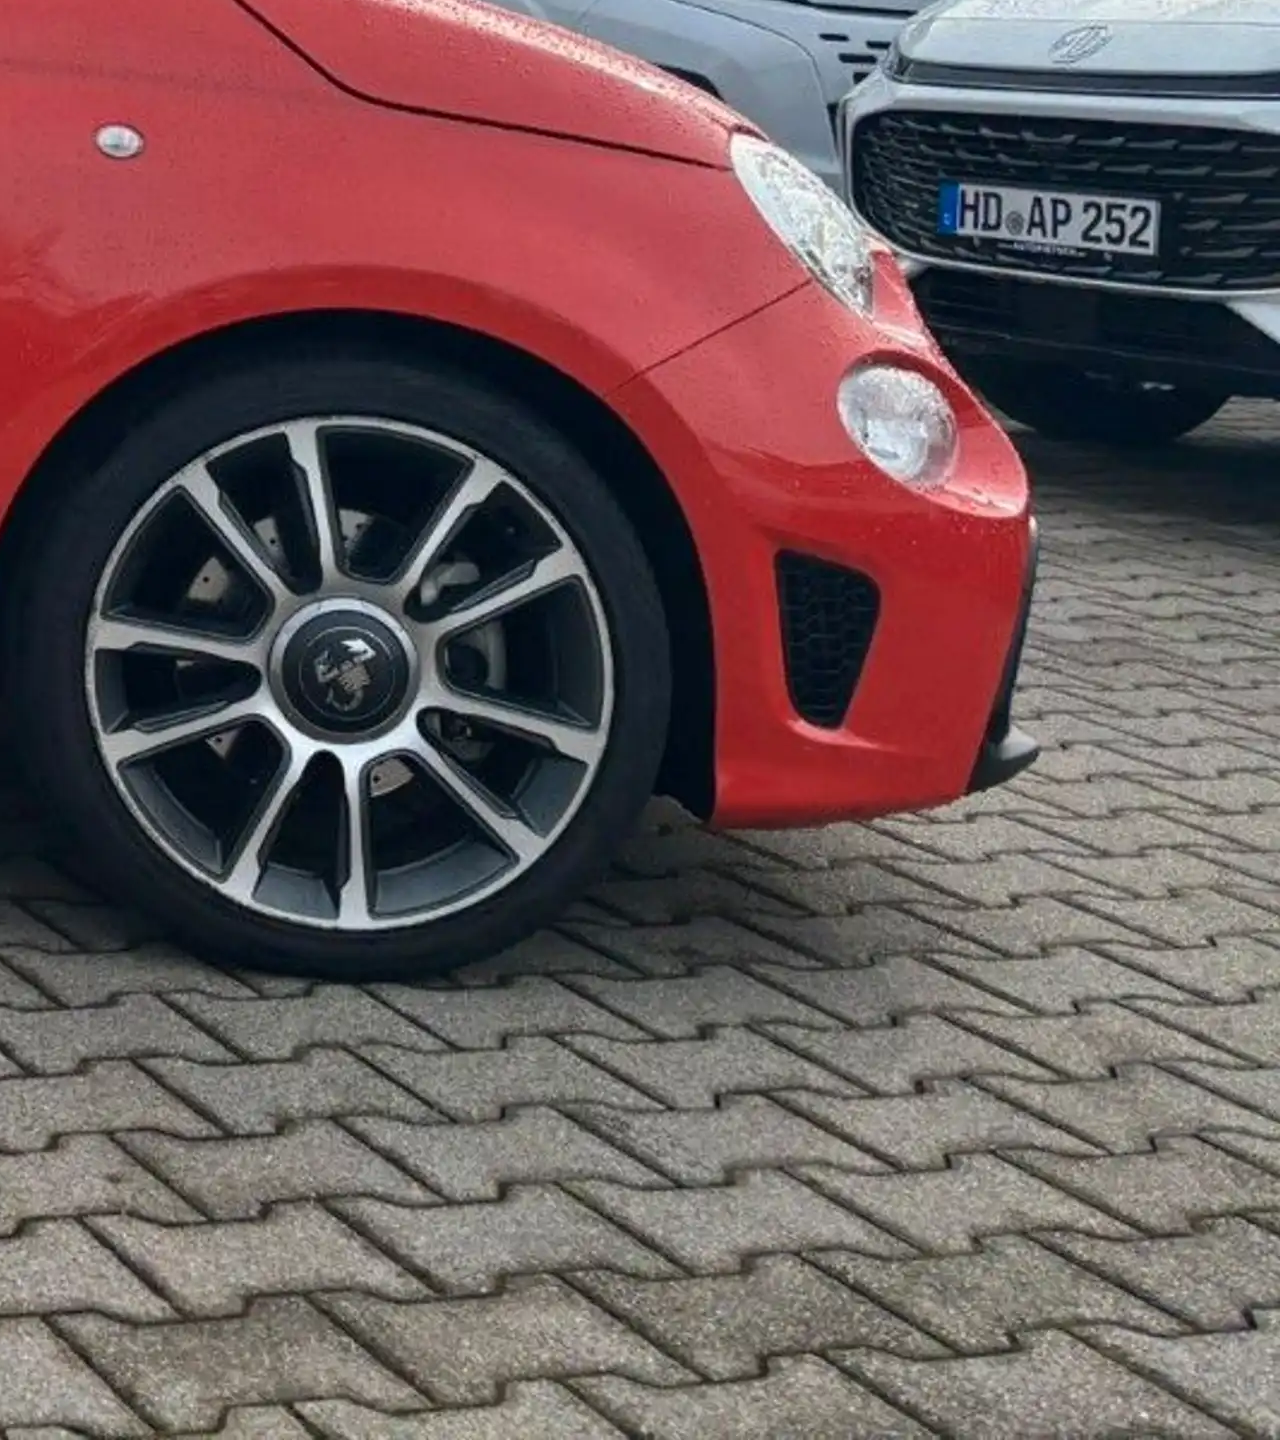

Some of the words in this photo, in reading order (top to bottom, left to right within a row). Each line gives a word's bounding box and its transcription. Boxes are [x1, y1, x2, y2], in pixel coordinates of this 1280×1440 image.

[958, 189, 1003, 232] HD
[1026, 195, 1072, 239] AP
[1081, 200, 1153, 249] 252
